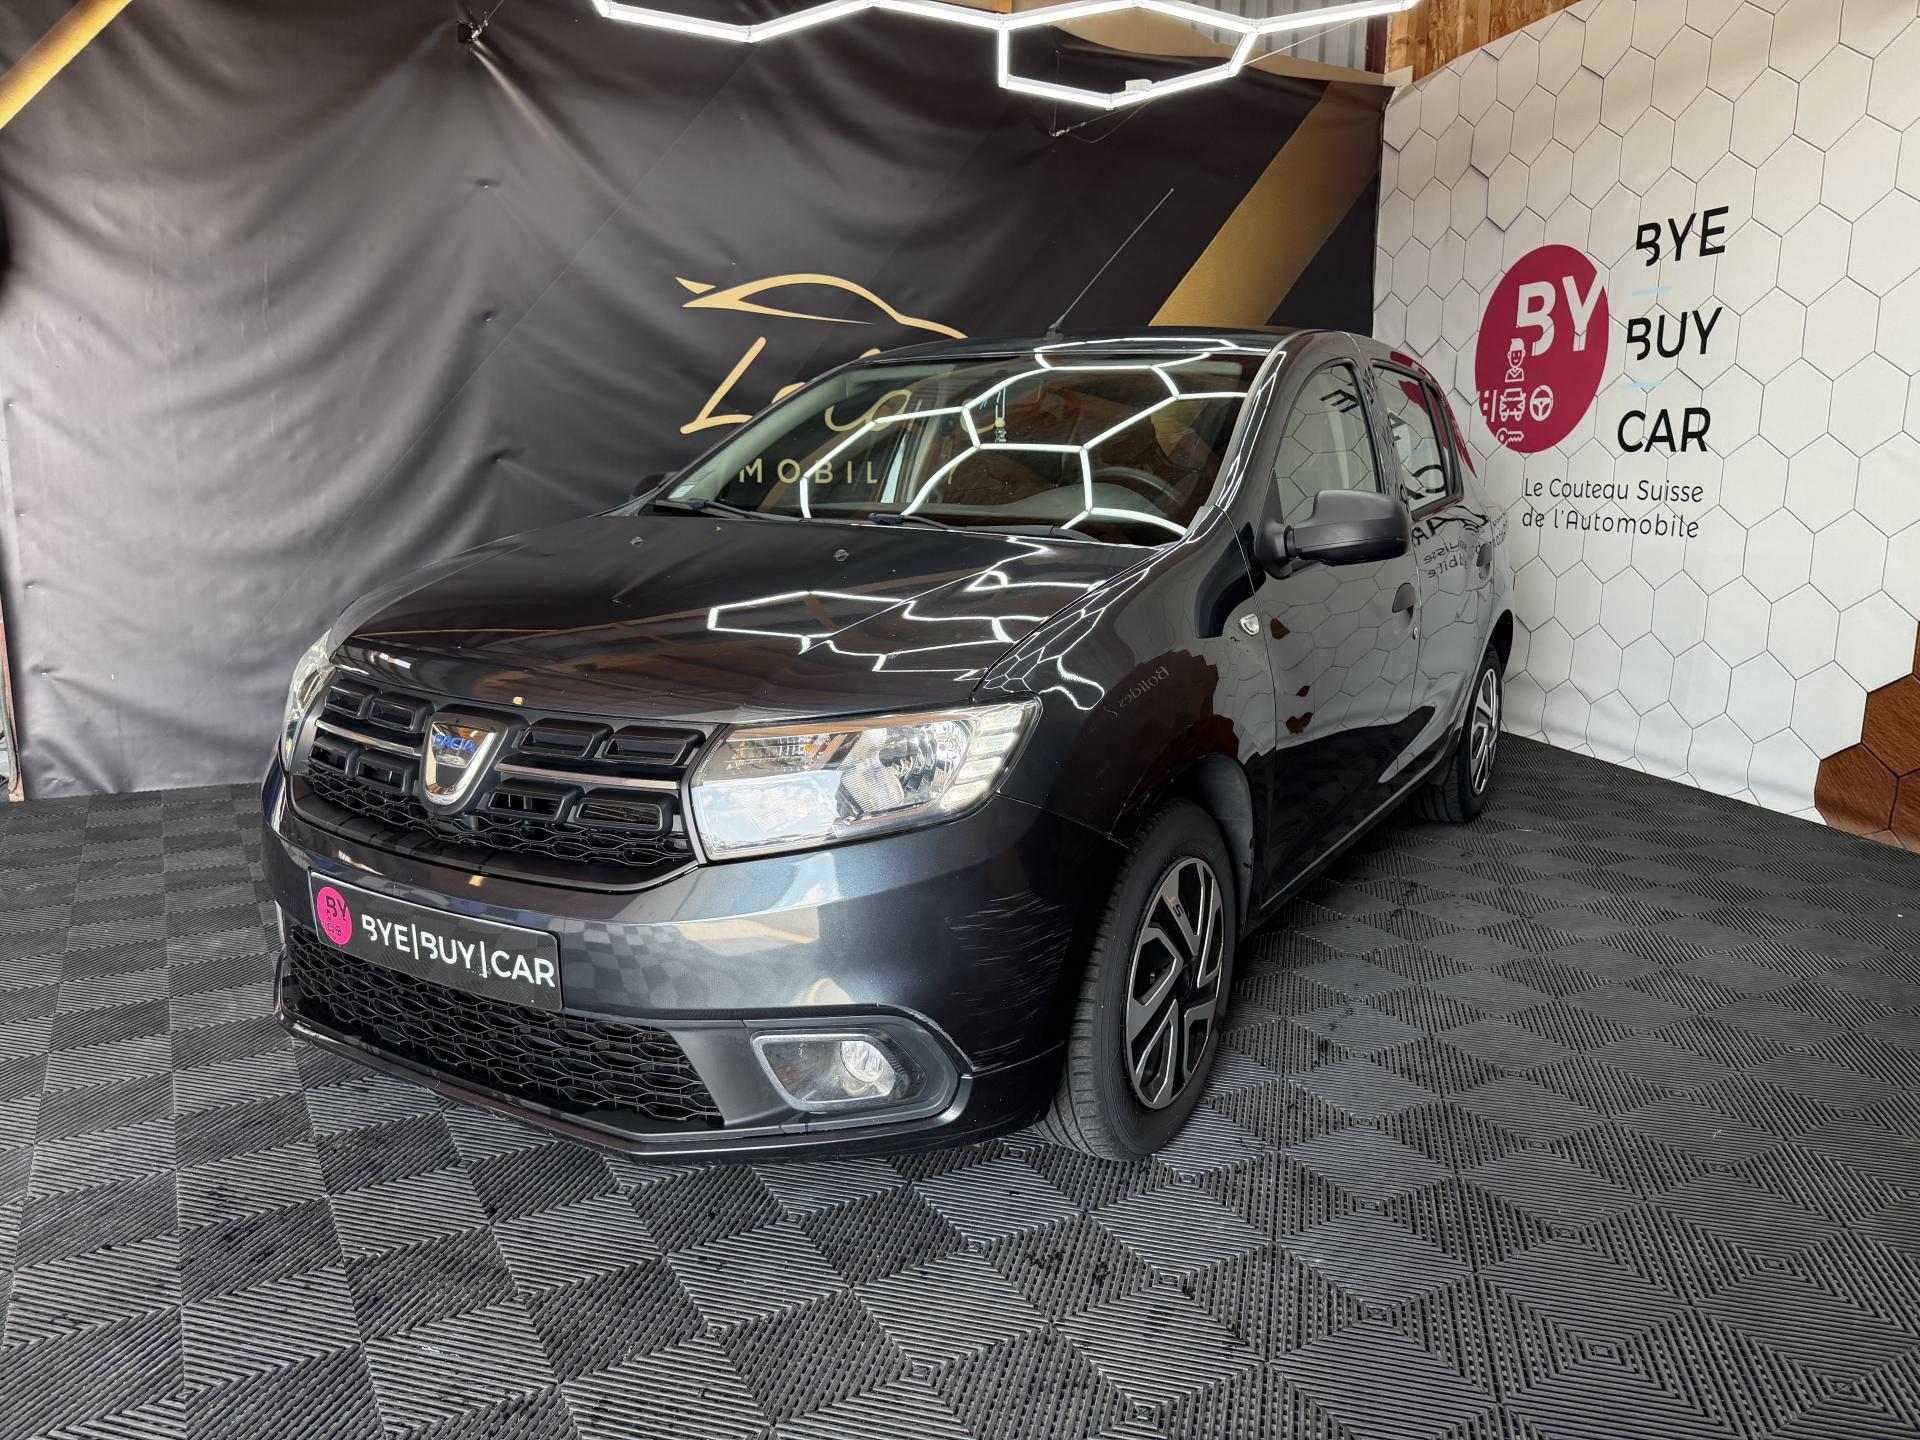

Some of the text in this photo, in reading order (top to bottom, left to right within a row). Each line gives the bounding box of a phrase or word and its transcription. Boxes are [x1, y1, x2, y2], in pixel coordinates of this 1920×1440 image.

[1636, 205, 1729, 267] BYE
[1515, 275, 1603, 357] BY
[1626, 307, 1722, 361] BUY
[1617, 407, 1711, 452] CAR
[1525, 478, 1704, 503] Le Couteau Suisse
[1522, 508, 1699, 538] de l'Automobile
[433, 732, 475, 752] DACIA
